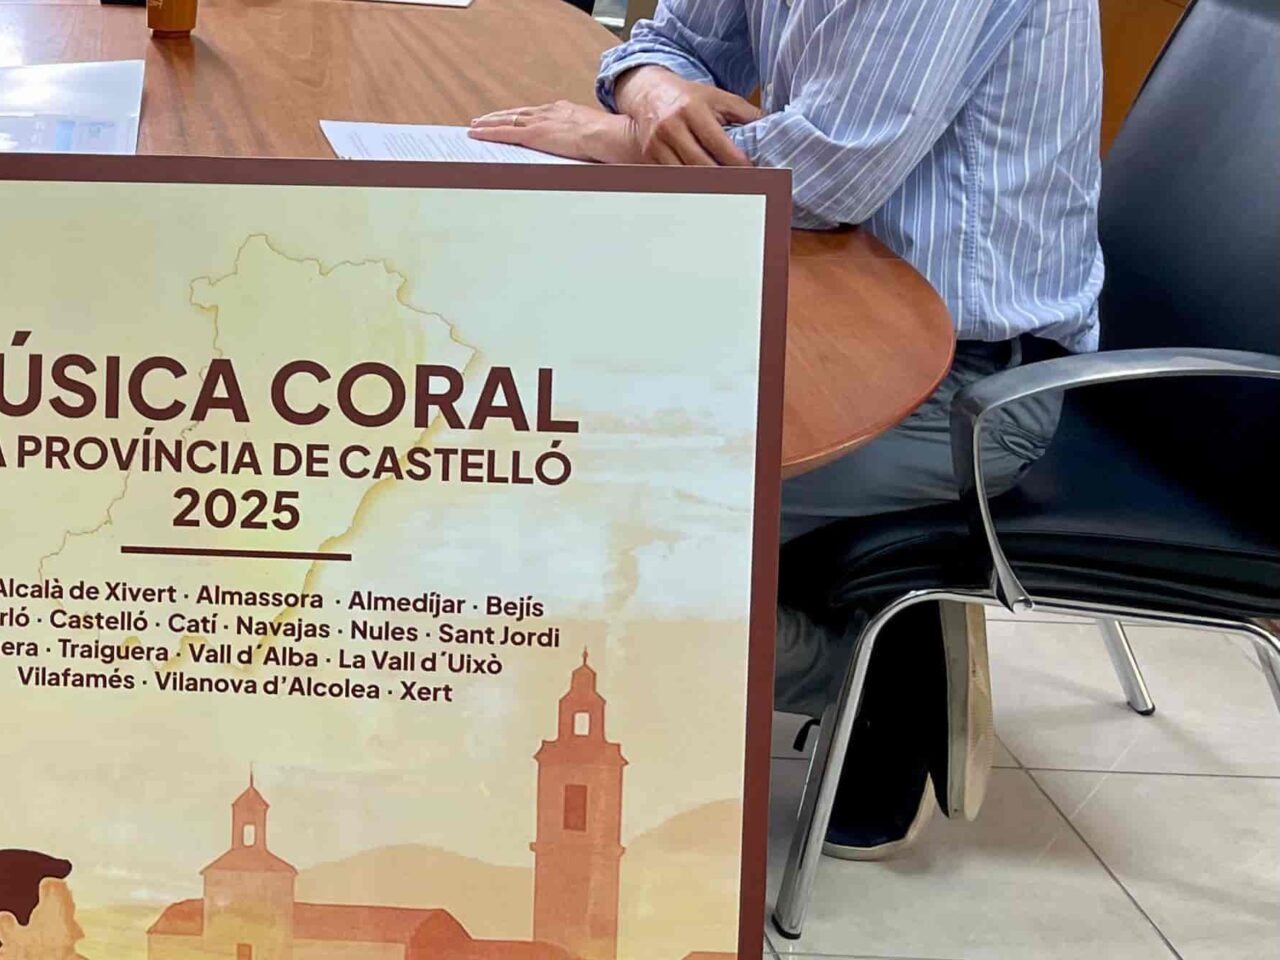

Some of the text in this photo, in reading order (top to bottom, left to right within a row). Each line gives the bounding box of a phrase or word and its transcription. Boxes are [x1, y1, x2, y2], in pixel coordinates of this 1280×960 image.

[270, 359, 580, 434] CORAL
[17, 426, 263, 476] PROVÍNCIA
[272, 442, 330, 478] DE
[339, 439, 572, 486] CASTELLÓ
[172, 486, 300, 531] 2025
[68, 580, 100, 601] de
[104, 581, 177, 604] Xivert
[195, 584, 324, 609] Almassora
[347, 590, 467, 619] Almedíjar
[486, 595, 544, 622] Bejís
[49, 608, 149, 632] Castelló
[168, 612, 219, 635] Catí
[236, 615, 331, 643] Navajas
[350, 619, 419, 642] Nules
[438, 623, 496, 645] Sant
[499, 625, 560, 648] Jordi
[57, 638, 169, 665] Traiguera
[188, 642, 232, 665] Vall
[338, 648, 366, 670] La
[371, 649, 416, 672] Vall
[17, 665, 135, 690] Vilafamés
[154, 670, 257, 695] Vilanova
[399, 680, 453, 703] Xert
